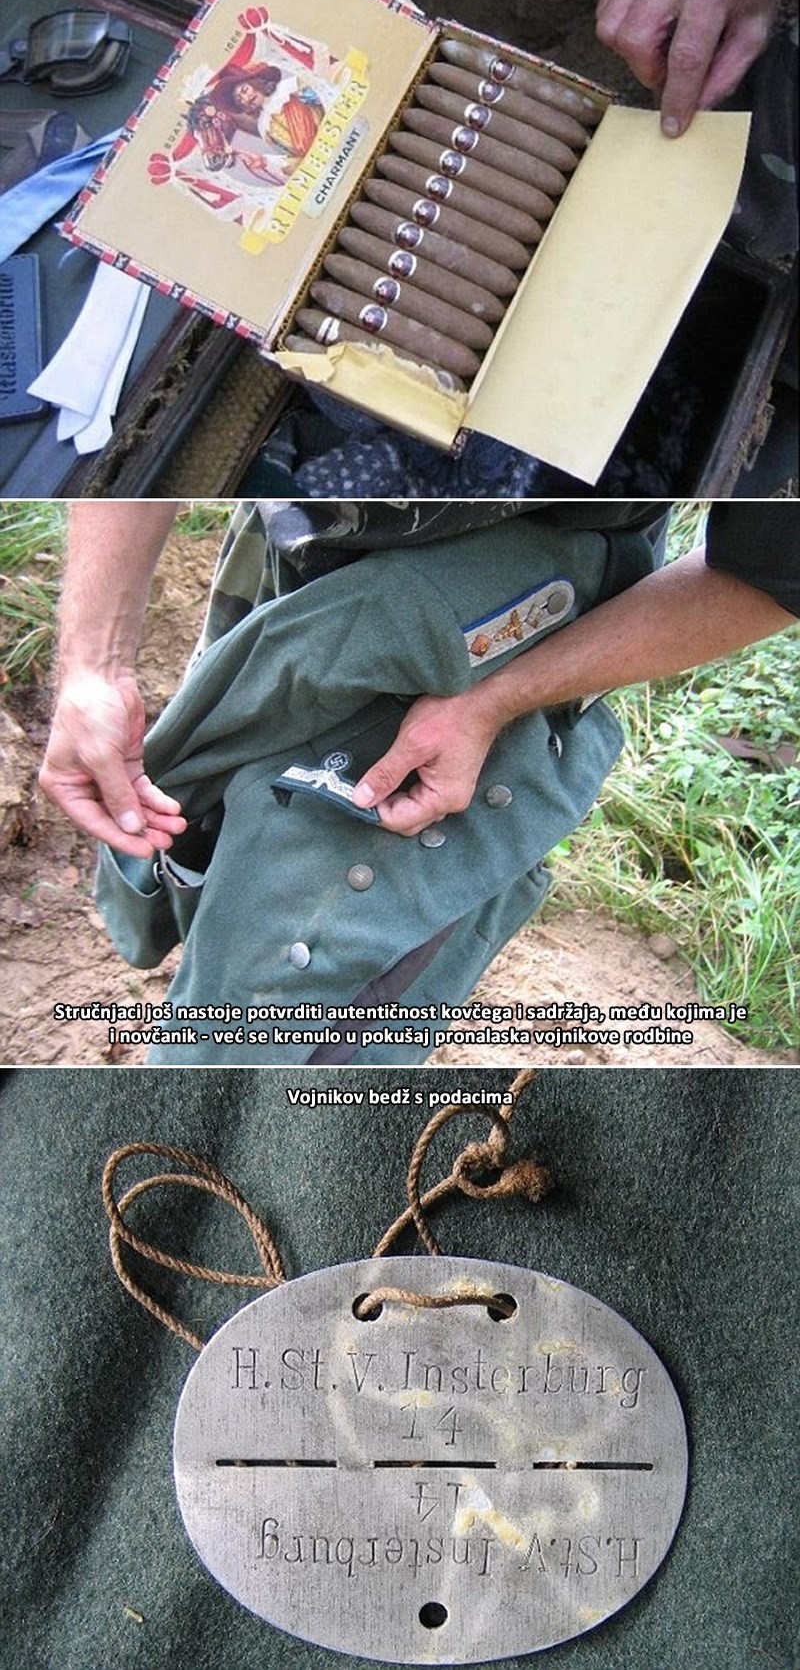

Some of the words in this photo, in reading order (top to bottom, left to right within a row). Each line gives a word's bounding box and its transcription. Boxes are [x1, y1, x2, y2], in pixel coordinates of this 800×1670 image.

[314, 127, 362, 205] CHARMANT
[402, 1349, 647, 1409] Insterburg
[400, 1402, 464, 1446] 14
[258, 1517, 500, 1577] Insterburg
